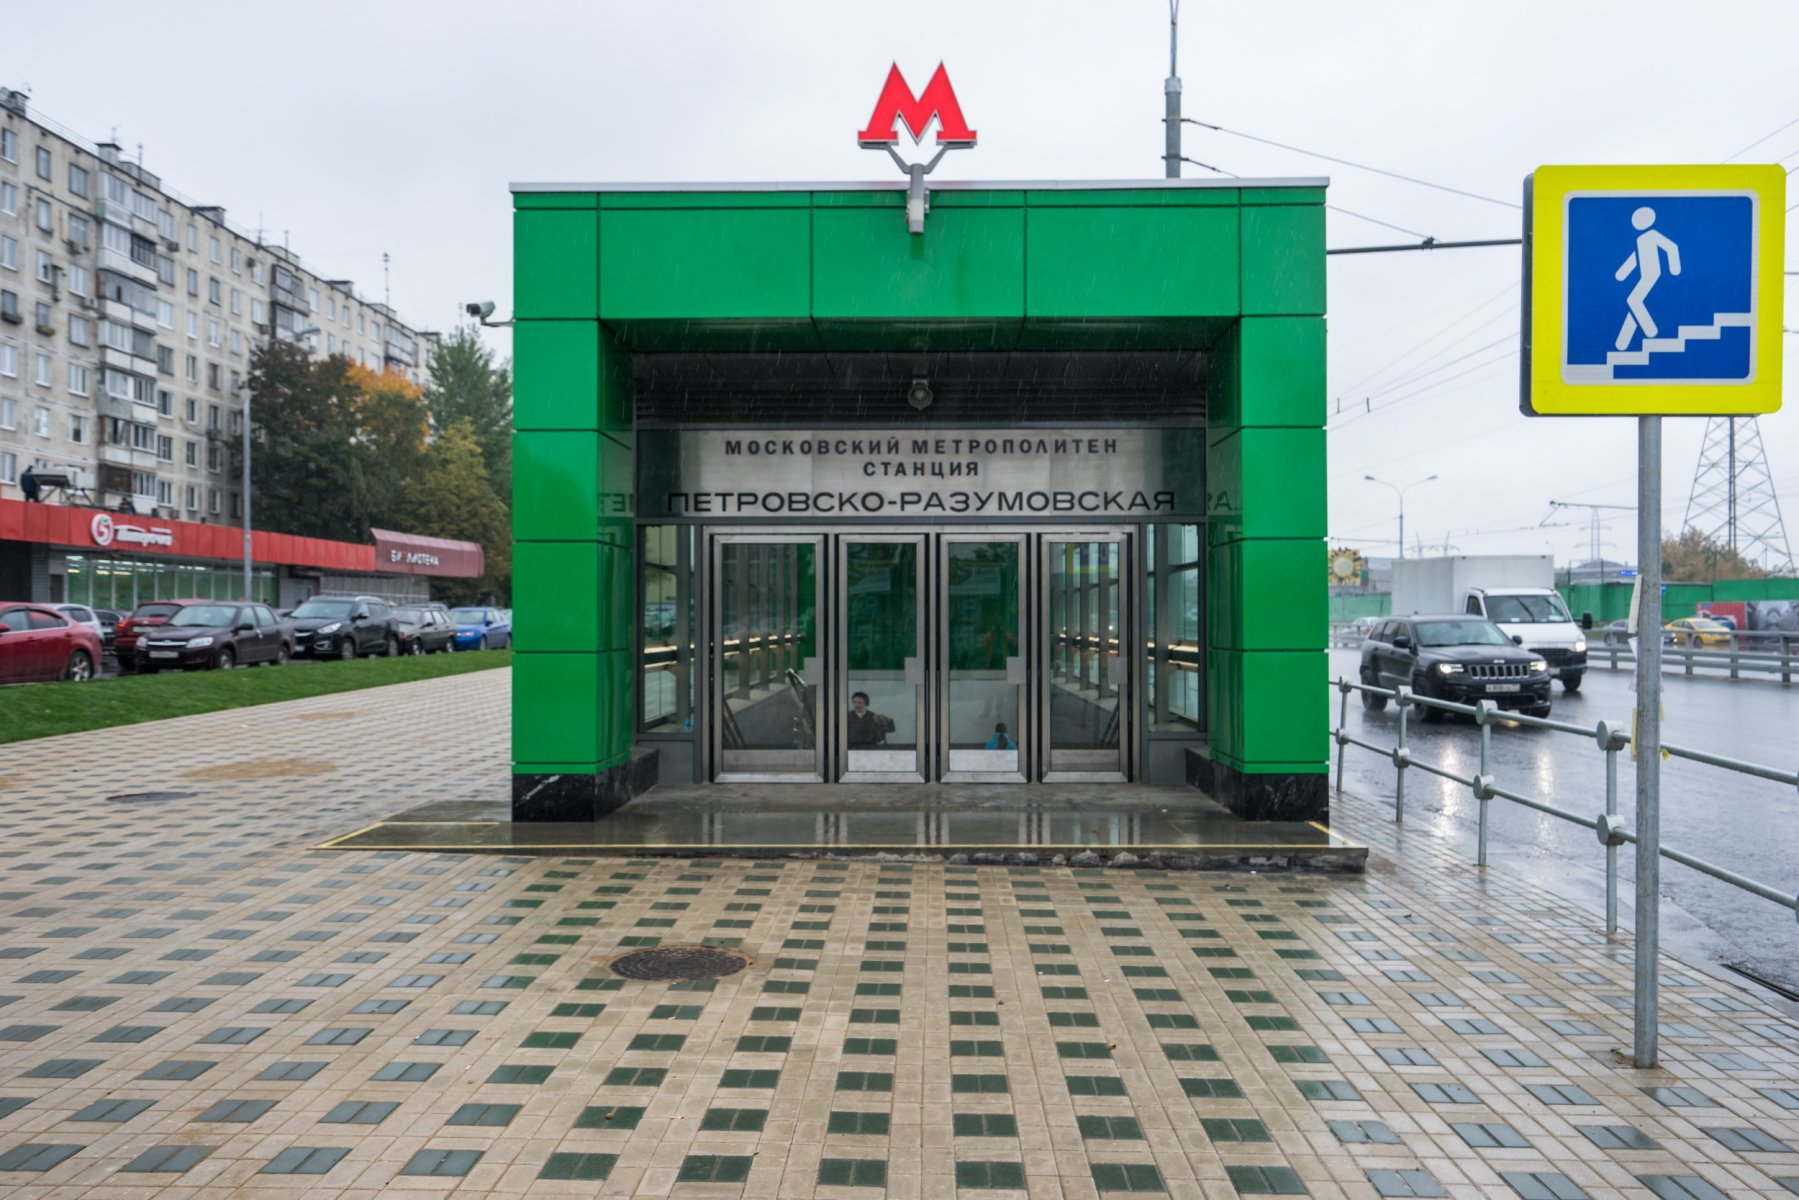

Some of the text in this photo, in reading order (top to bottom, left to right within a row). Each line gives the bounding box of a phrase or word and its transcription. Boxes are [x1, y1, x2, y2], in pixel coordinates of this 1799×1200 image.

[857, 61, 977, 146] М
[725, 436, 1117, 456] МОСКОВСКИЙ МЕТРОПОЛИТЕН
[863, 461, 979, 479] СТАНЦИЯ
[667, 491, 1176, 513] ПЕТРОВСКО-РАЗУМОВСКАЯ
